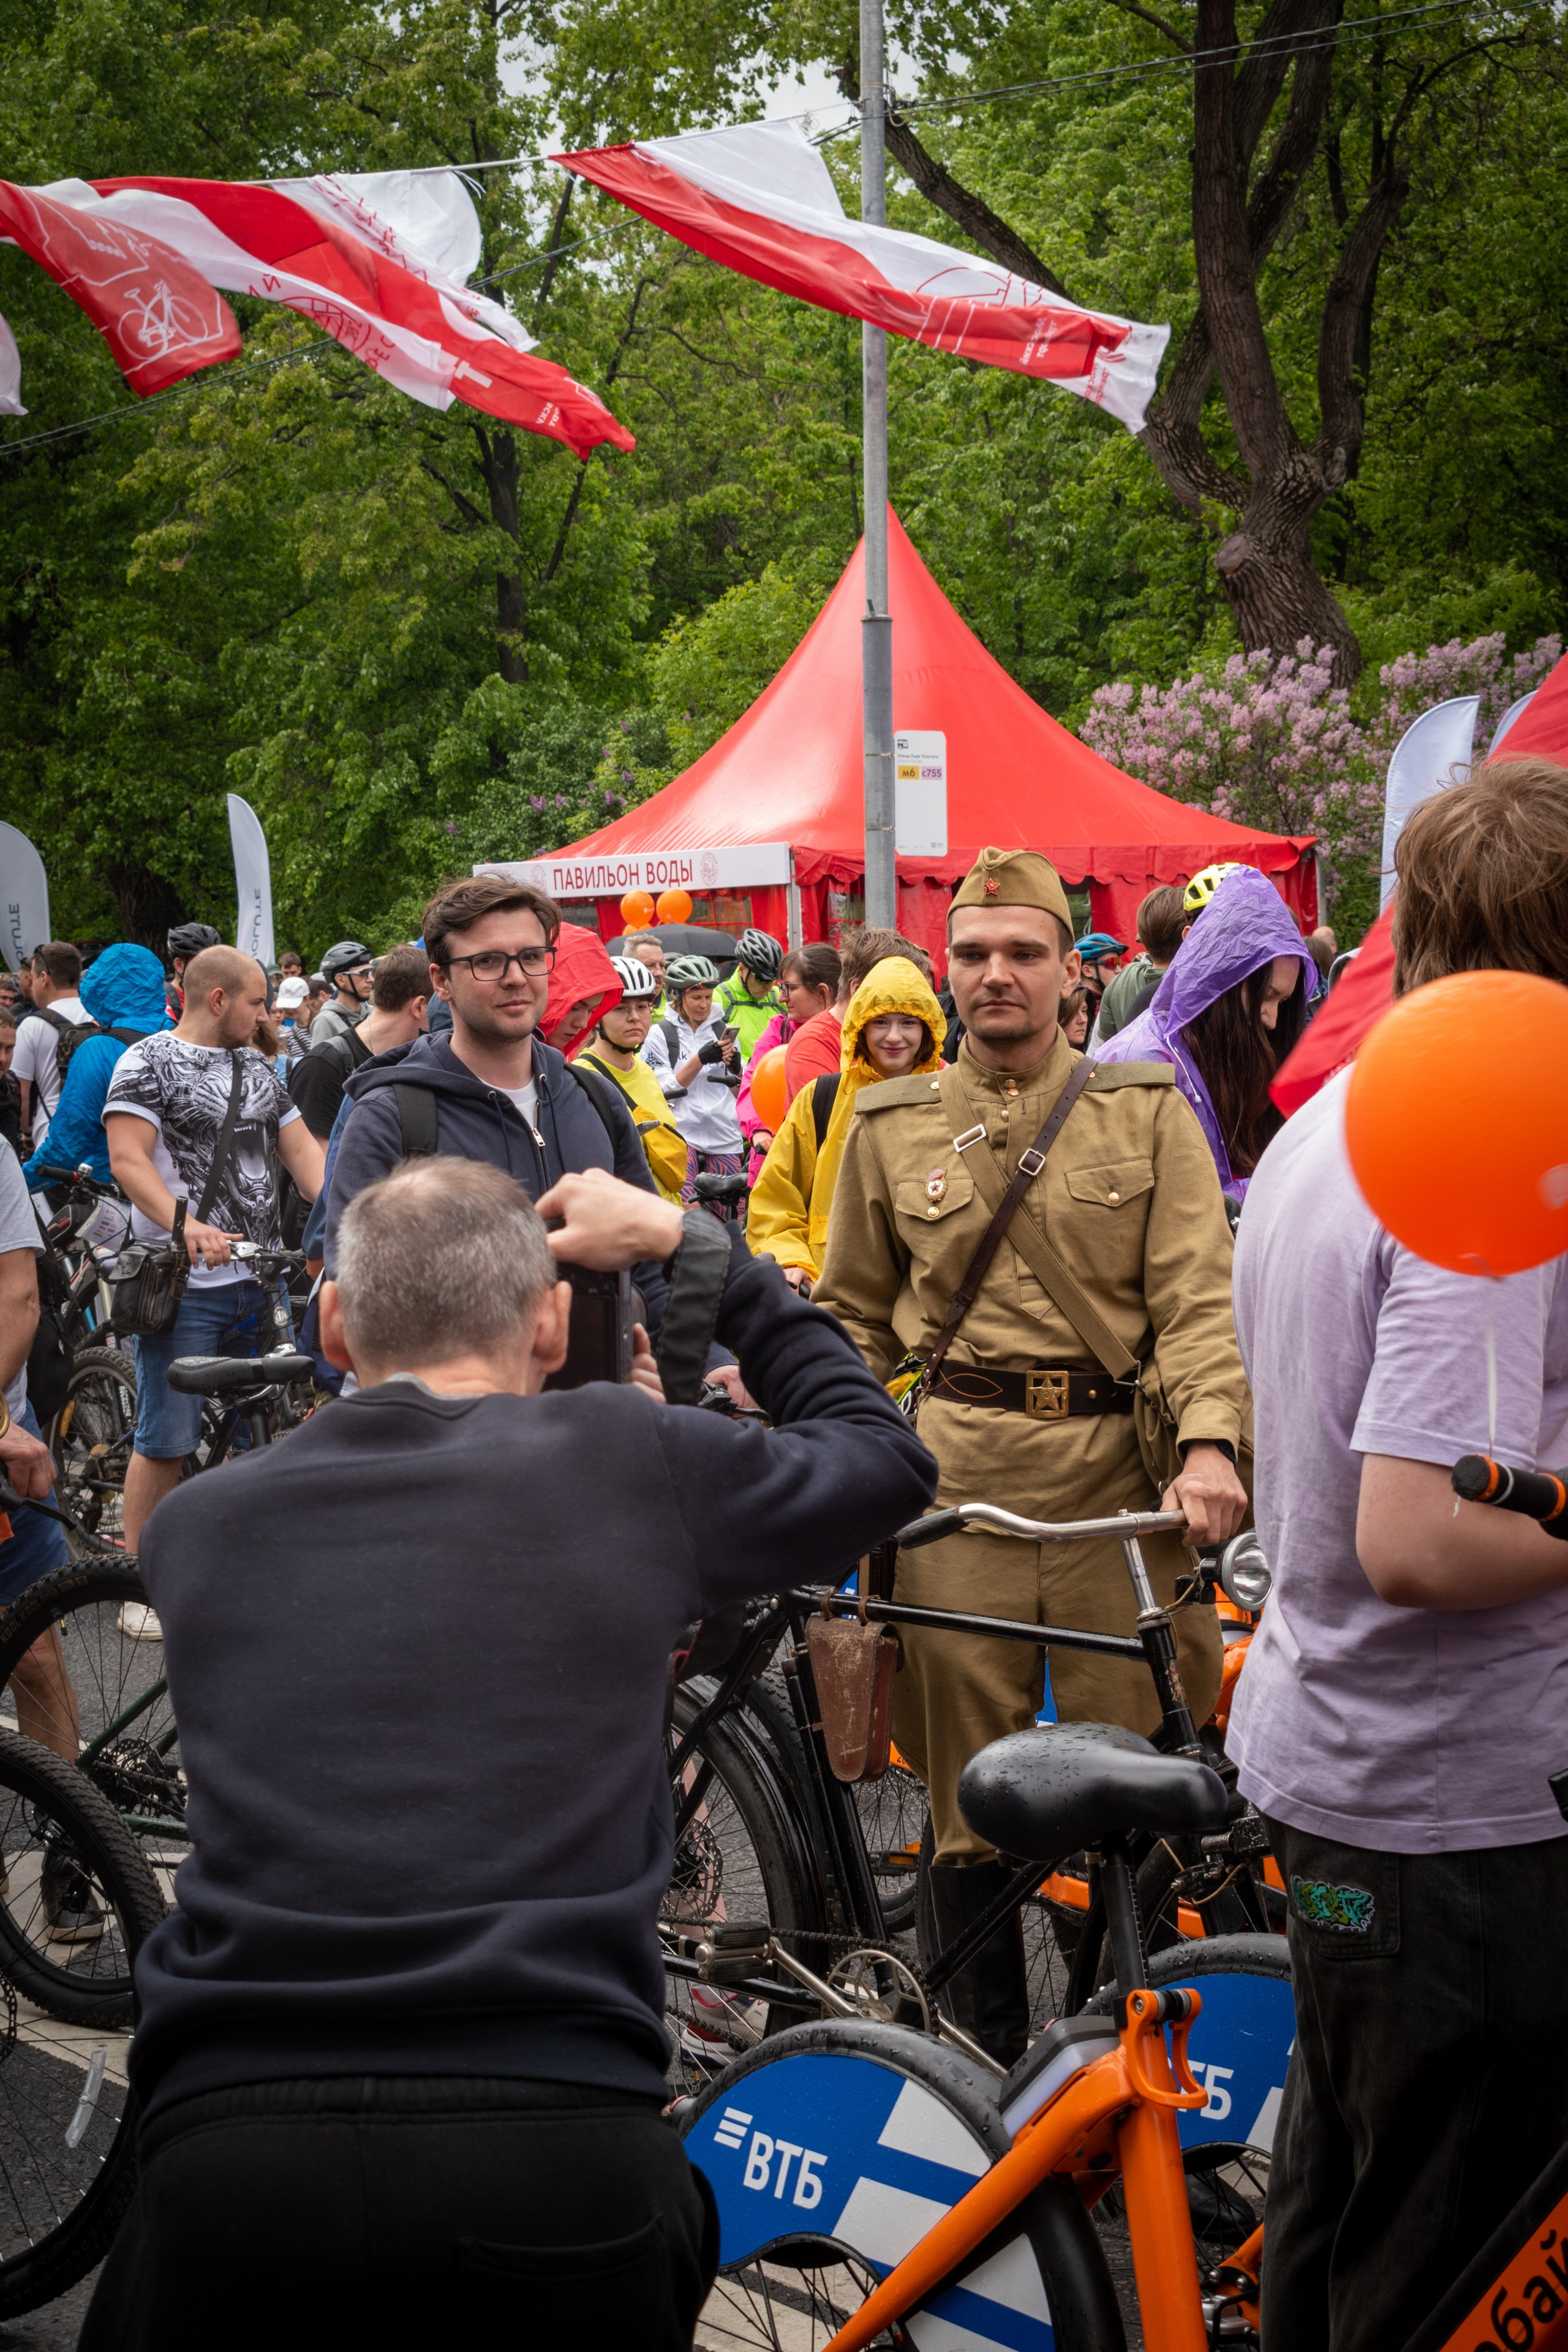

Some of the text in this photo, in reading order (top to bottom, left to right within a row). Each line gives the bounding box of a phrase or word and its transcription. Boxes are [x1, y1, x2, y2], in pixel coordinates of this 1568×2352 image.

[553, 863, 639, 891] ПАВИЛЬОН
[646, 859, 693, 888] ВОДЫ
[743, 2131, 828, 2210] ВТБ
